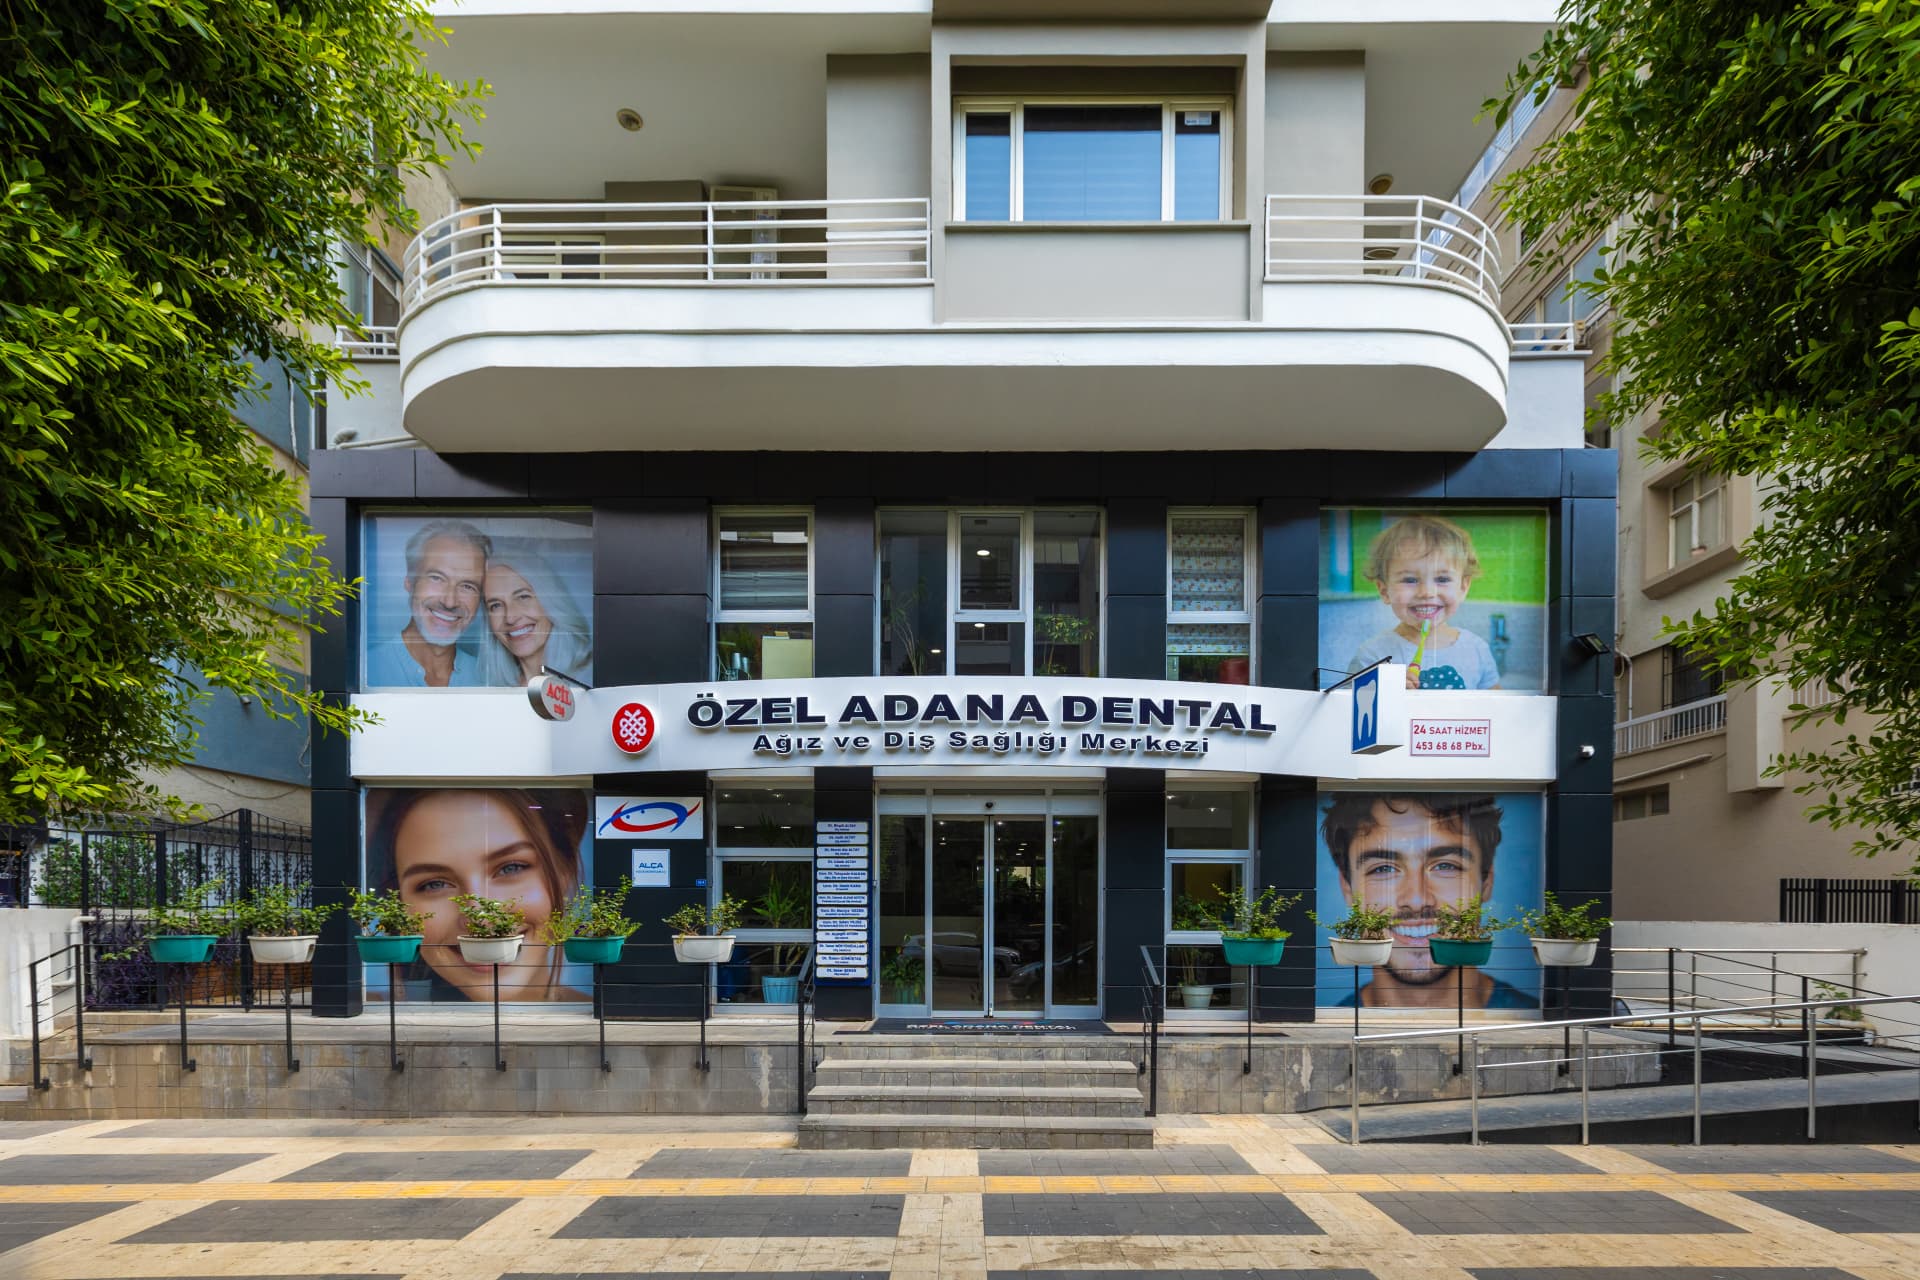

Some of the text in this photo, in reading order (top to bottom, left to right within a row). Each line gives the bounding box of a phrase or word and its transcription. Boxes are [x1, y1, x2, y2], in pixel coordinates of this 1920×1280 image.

[688, 693, 1277, 733] ÖZEL ADANA DENTAL
[1413, 724, 1488, 735] 24 SAAT HİZMET
[754, 731, 1208, 758] Ağız ve Diş Sağlığı Merkezi
[1416, 741, 1486, 750] 453 68 68 Pbx.
